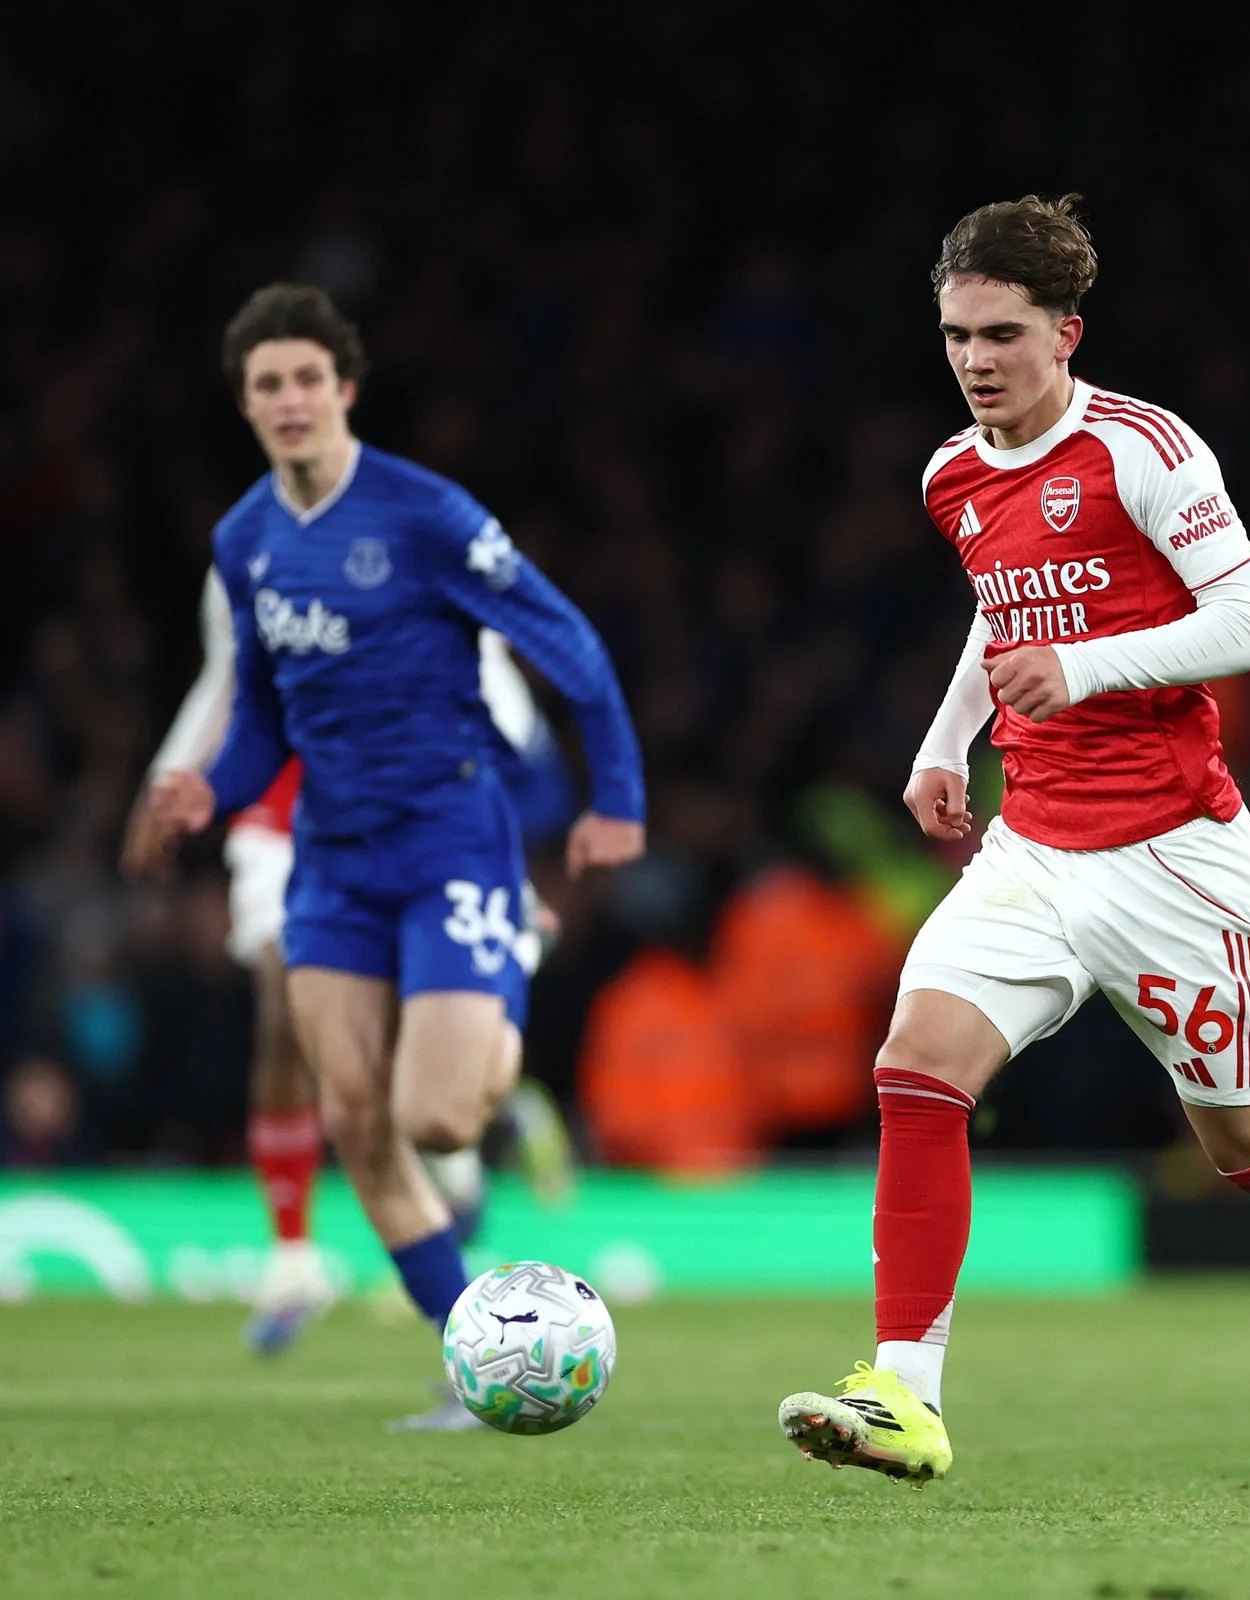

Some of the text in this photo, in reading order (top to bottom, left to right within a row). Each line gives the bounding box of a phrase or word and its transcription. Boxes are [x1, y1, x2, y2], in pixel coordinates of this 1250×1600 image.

[1046, 486, 1075, 495] Arsenal
[1178, 495, 1221, 524] VISIT
[1168, 508, 1235, 551] RWAND
[966, 557, 1111, 607] mirates
[1009, 602, 1090, 643] BETTER
[1137, 973, 1235, 1055] 56
